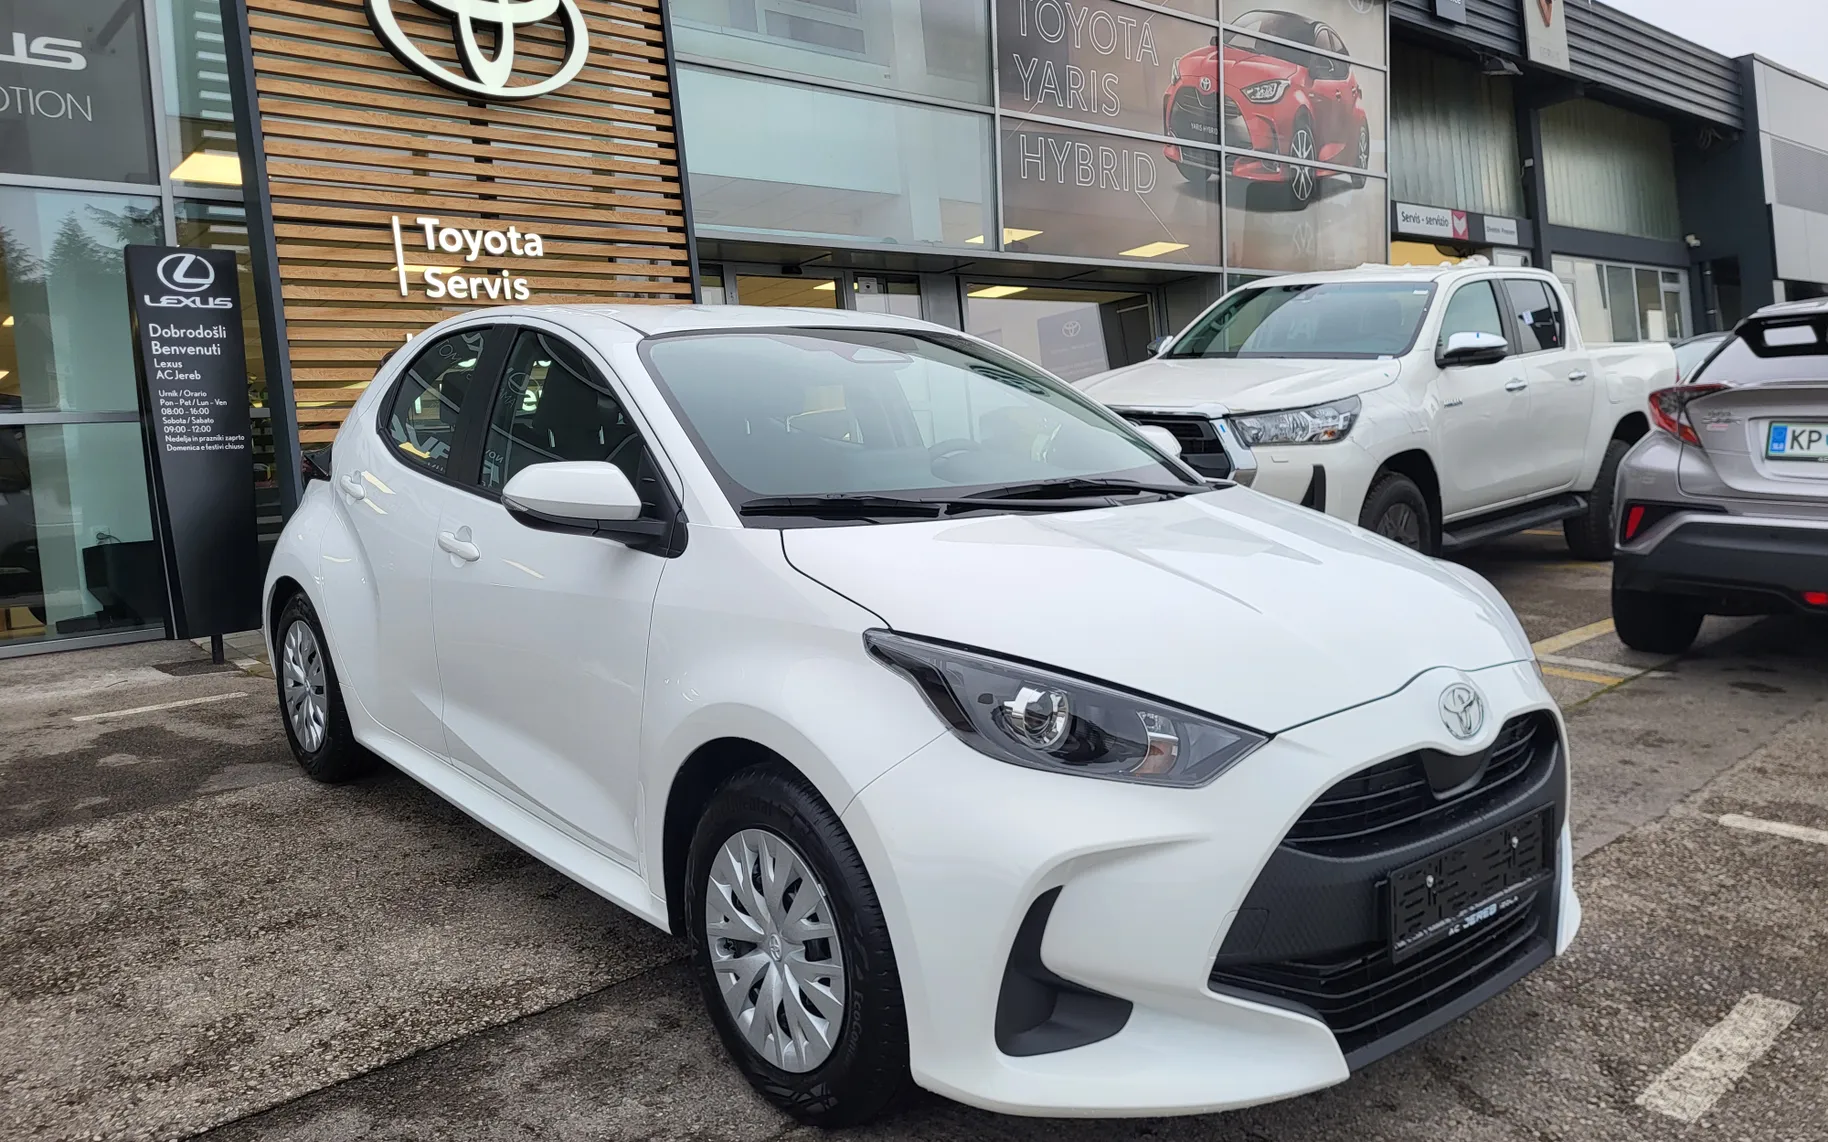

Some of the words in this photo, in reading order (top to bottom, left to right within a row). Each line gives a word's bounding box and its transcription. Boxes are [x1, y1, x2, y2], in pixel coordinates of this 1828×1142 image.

[1019, 0, 1159, 66] TOYOTA
[1013, 53, 1120, 117] YARIS
[1020, 134, 1156, 193] HYBRID
[1401, 211, 1420, 224] Servis
[1425, 215, 1449, 227] servizio
[416, 217, 544, 262] Toyota
[423, 267, 530, 300] Servis
[144, 294, 233, 309] LEXUS
[148, 323, 227, 338] Dobrodošli
[151, 341, 221, 355] Benvenuti
[153, 358, 183, 368] Lexus
[156, 370, 173, 380] AC
[158, 389, 178, 397] Urnik
[183, 389, 207, 397] Orario
[214, 398, 228, 406] Ven
[161, 407, 184, 415] 08:00
[190, 407, 210, 415] 16:00
[162, 416, 187, 424] Sobota
[191, 416, 215, 424] Sabato
[163, 425, 186, 433] 09:00
[191, 425, 212, 433] 12:00
[165, 434, 192, 444] Nedelja
[199, 434, 224, 443] prazniki
[225, 434, 245, 442] zaprto
[1789, 429, 1822, 450] KP
[166, 443, 200, 452] Domenica
[224, 442, 245, 450] chiuso
